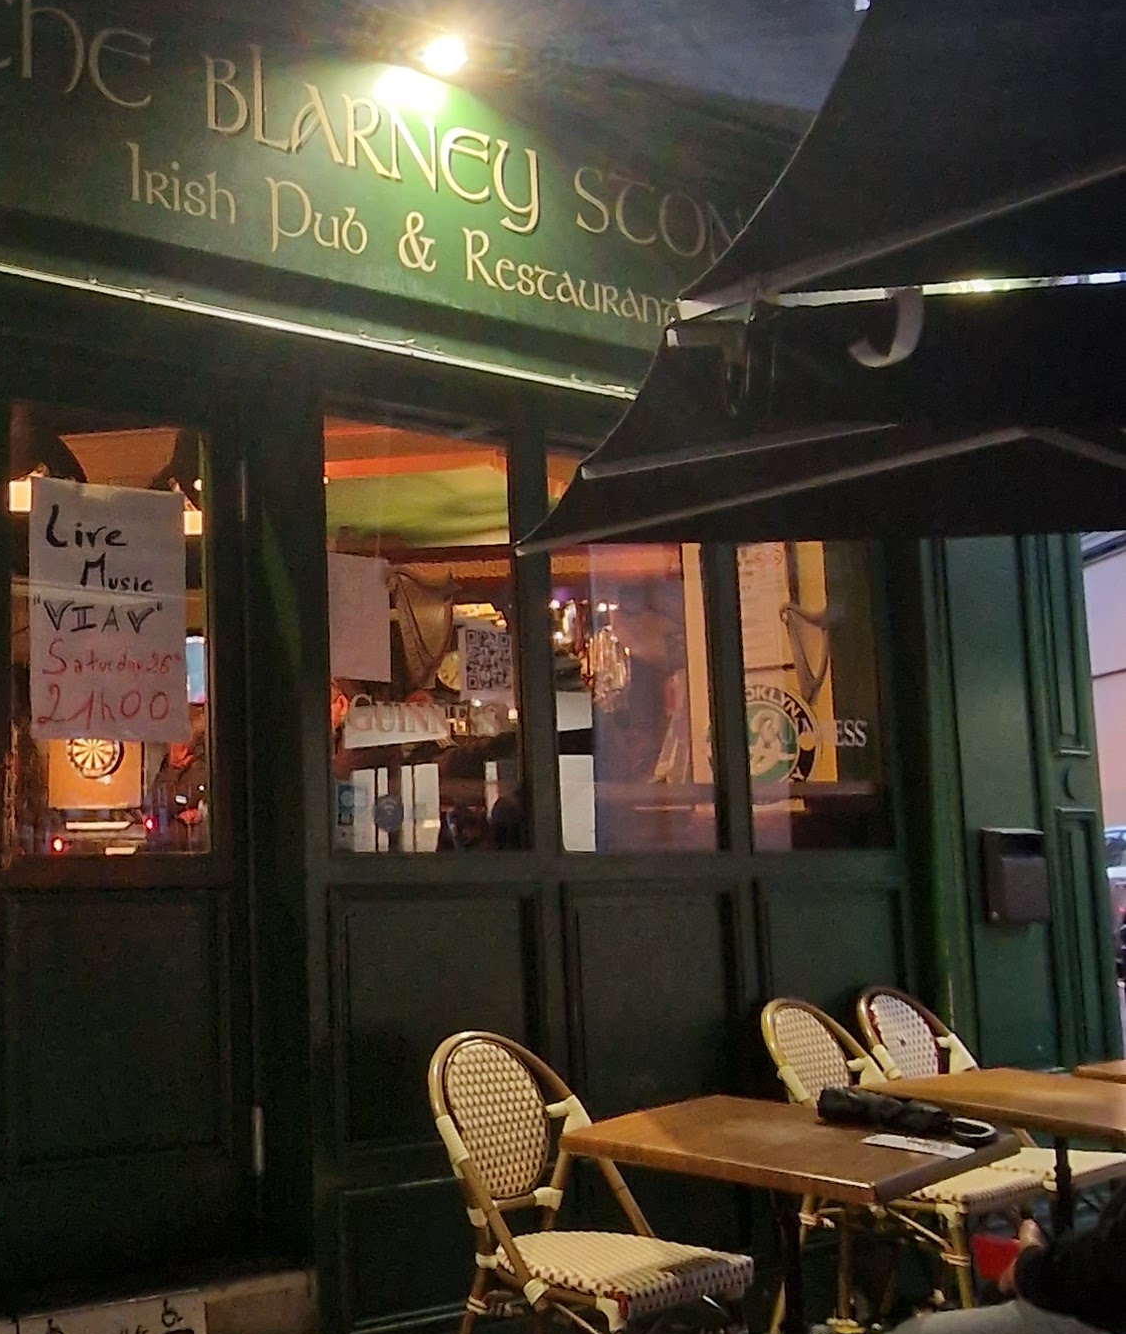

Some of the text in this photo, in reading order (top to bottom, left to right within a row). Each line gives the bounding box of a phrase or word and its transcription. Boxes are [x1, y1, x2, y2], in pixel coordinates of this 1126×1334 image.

[126, 141, 678, 329] Irish Pub & Restaurant
[574, 167, 744, 265] STON
[45, 504, 128, 549] Live
[37, 683, 169, 731] 21h00
